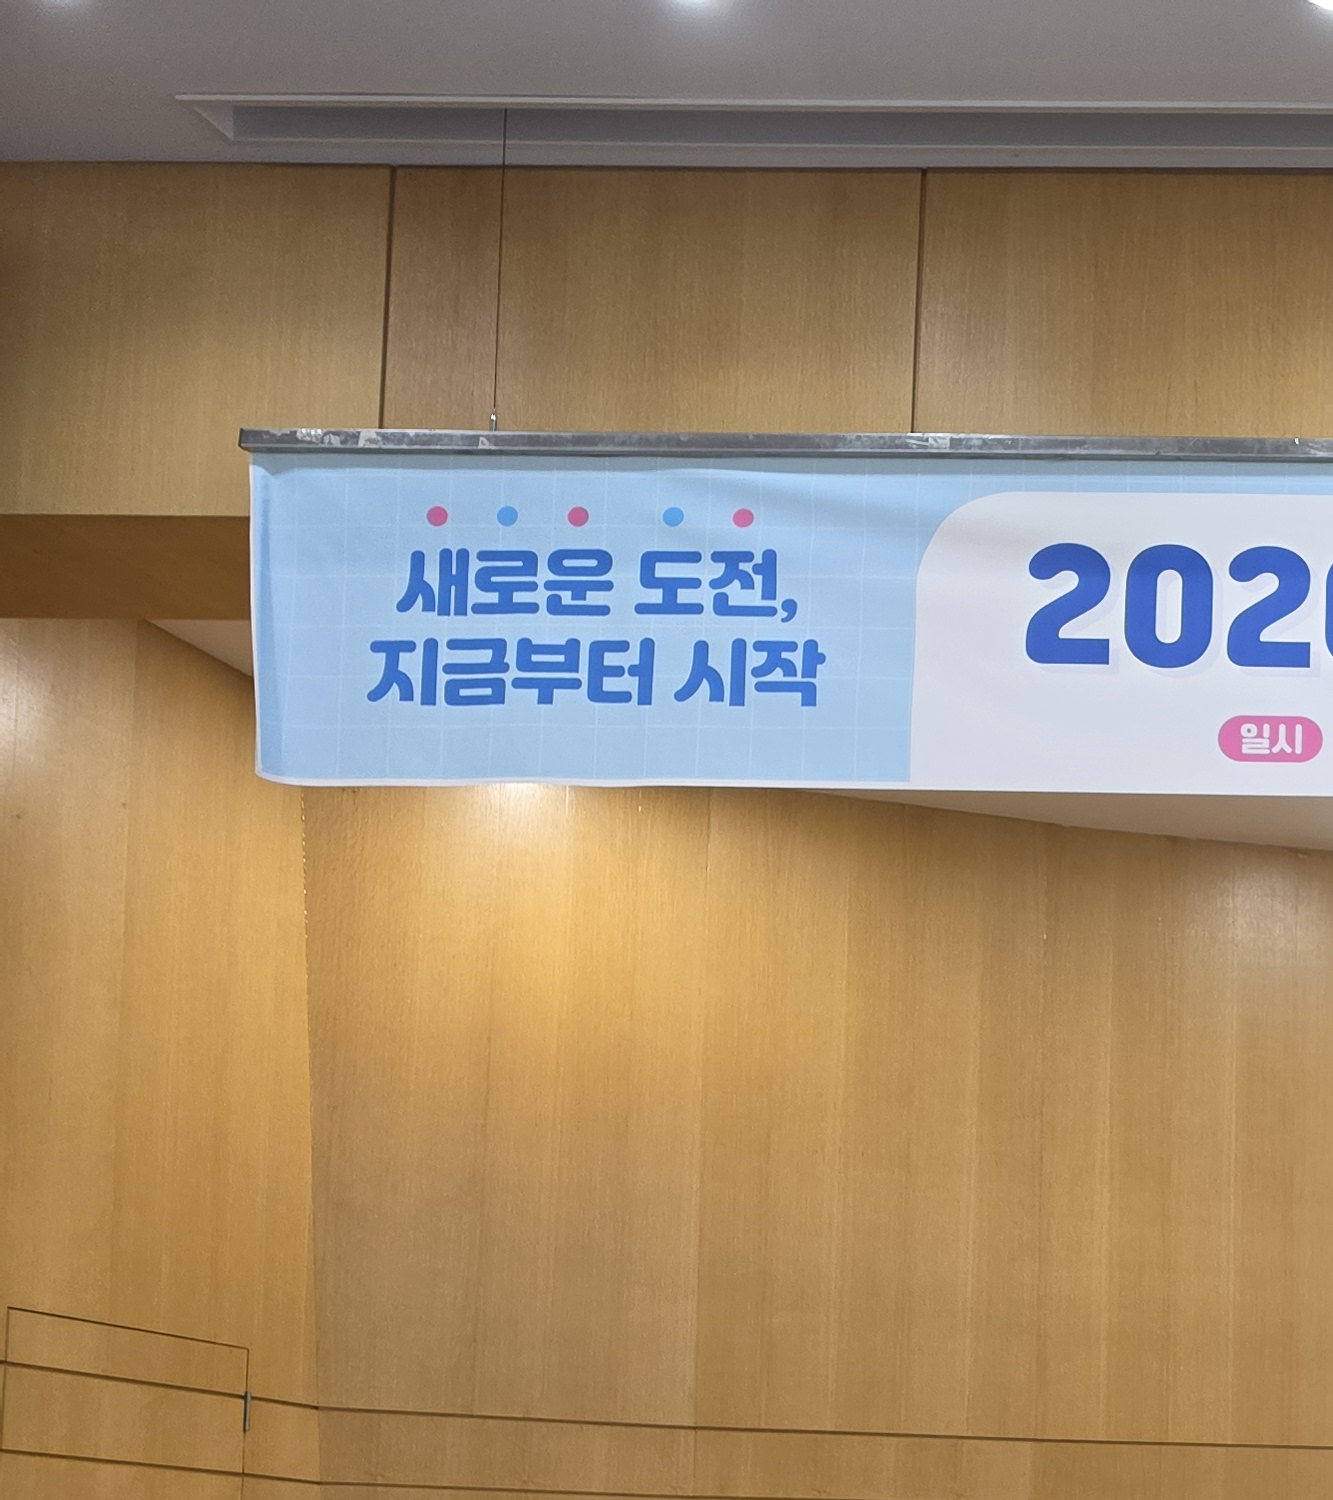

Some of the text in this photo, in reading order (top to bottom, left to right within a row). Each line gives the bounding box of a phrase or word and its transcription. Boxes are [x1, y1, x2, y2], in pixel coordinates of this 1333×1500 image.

[395, 547, 799, 624] 새로운 도전,
[366, 637, 827, 708] 지금부터 시작
[1240, 723, 1304, 756] 일시
